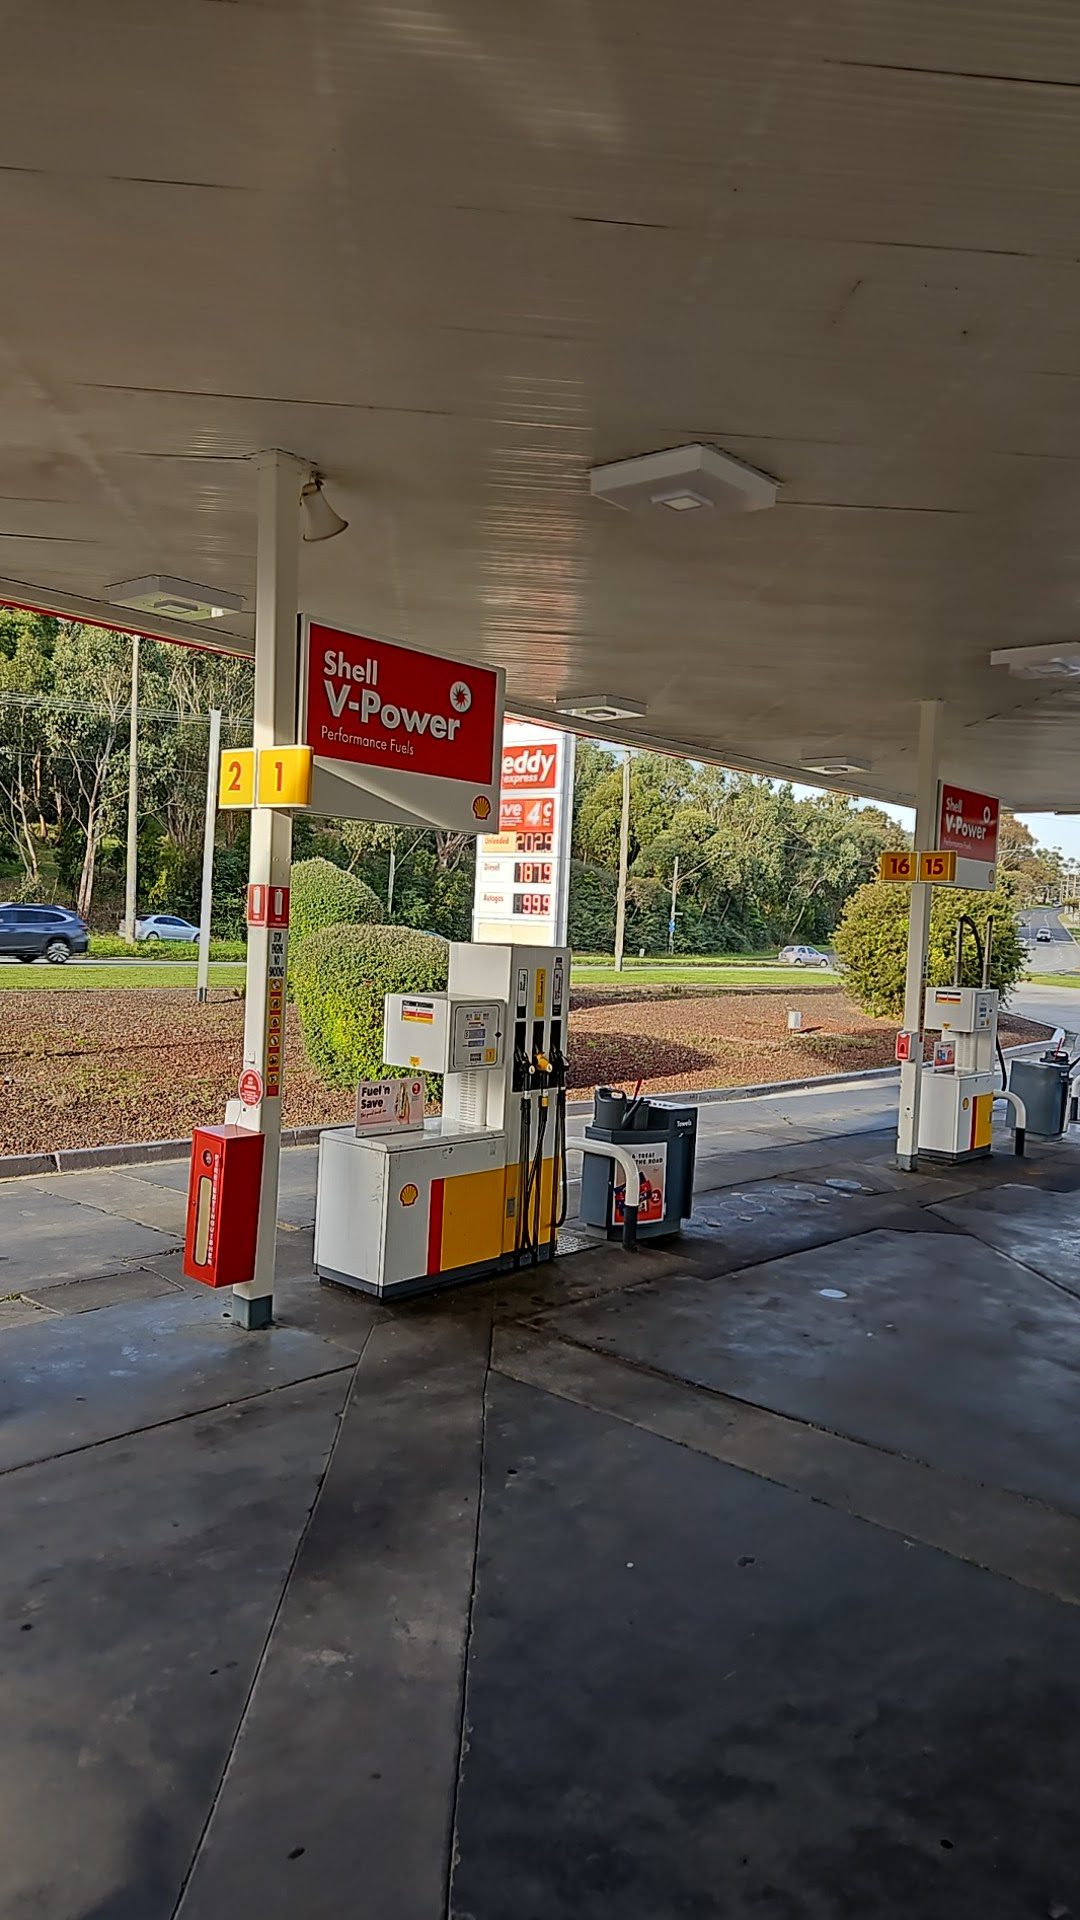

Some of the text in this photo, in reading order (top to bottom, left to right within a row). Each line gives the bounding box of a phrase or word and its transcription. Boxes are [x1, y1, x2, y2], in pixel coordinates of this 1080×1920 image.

[323, 650, 378, 686] Shell
[324, 679, 461, 741] V-Power
[321, 725, 414, 755] Performance Fuels
[228, 761, 241, 791] 2
[275, 762, 283, 791] 1
[946, 797, 963, 814] Shell
[945, 813, 987, 840] V-Power
[484, 836, 510, 845] Unleaded
[484, 863, 500, 871] Diesel
[890, 858, 910, 875] 16
[925, 858, 944, 875] 15
[483, 893, 504, 904] Autogas
[362, 1085, 381, 1097] Fuel
[361, 1099, 383, 1109] Save
[677, 1119, 692, 1127] Towels
